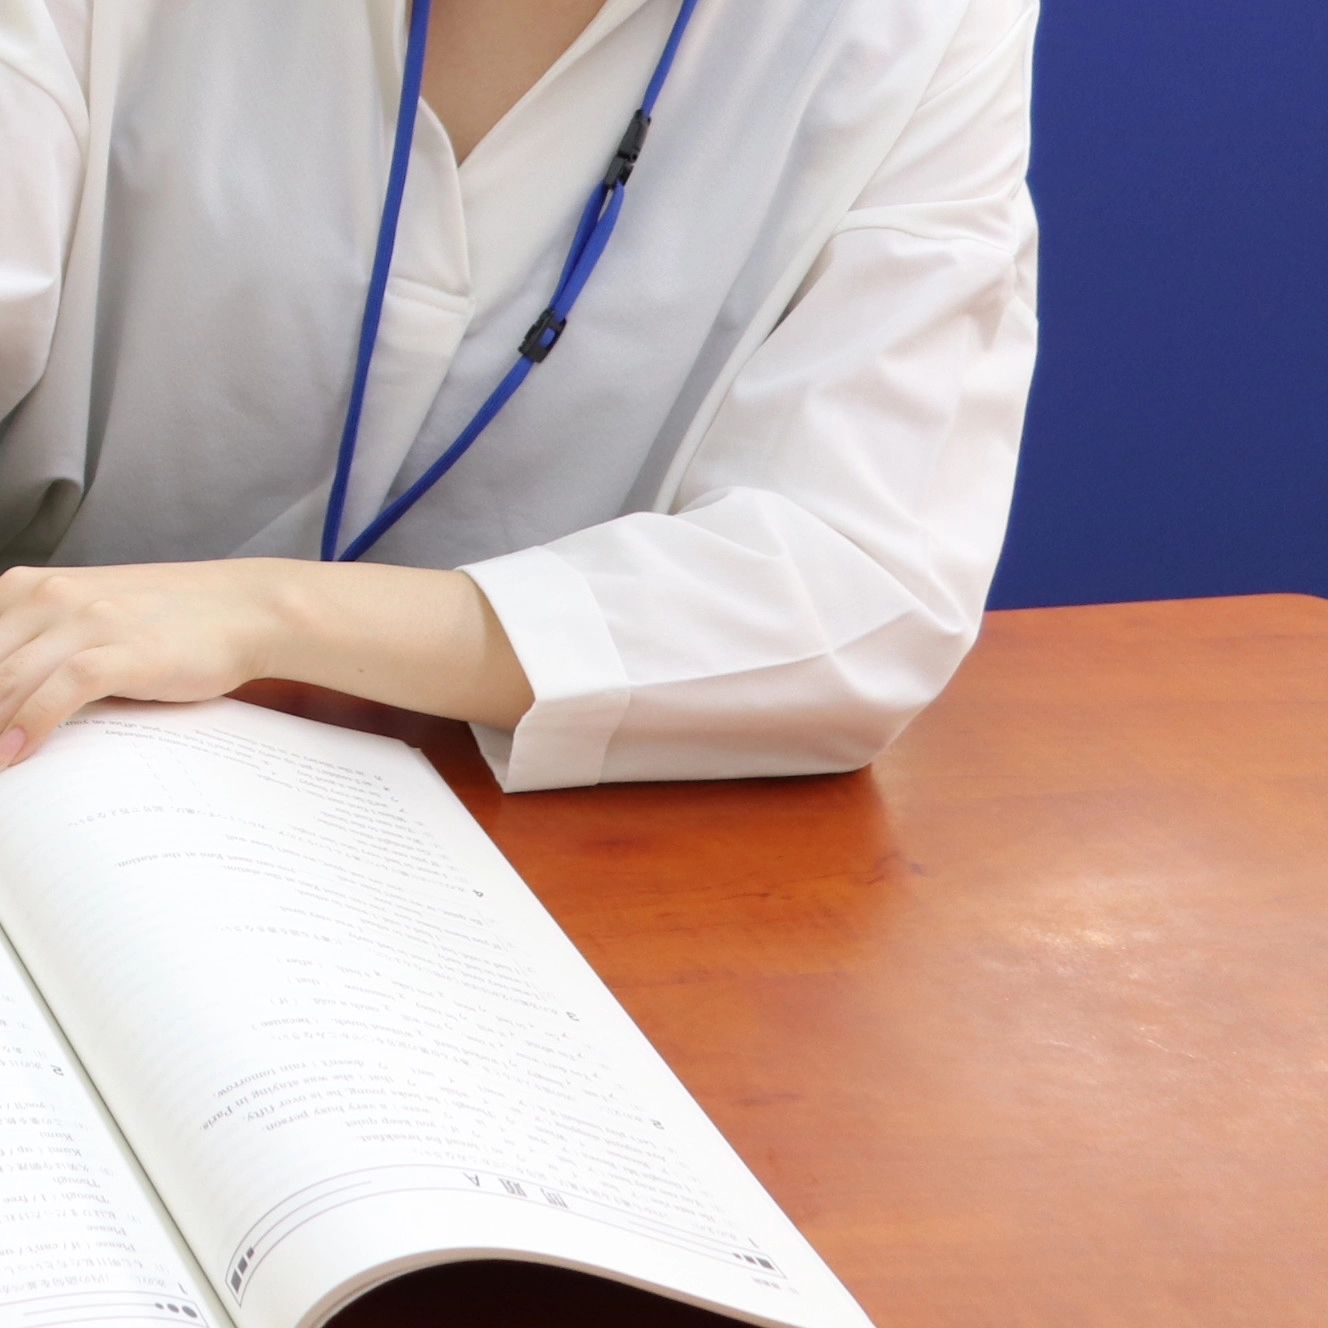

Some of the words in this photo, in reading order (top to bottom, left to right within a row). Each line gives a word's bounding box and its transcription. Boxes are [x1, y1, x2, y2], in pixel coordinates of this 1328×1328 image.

[14, 1101, 46, 1110] you'll
[40, 1132, 74, 1141] Kumi
[48, 1147, 82, 1157] Kumi
[53, 1176, 100, 1188] Though
[3, 1195, 28, 1203] free
[61, 1192, 110, 1204] Though
[87, 1225, 127, 1236] Please
[27, 1244, 58, 1254] can't
[71, 1242, 80, 1250] if
[96, 1242, 136, 1252] Please
